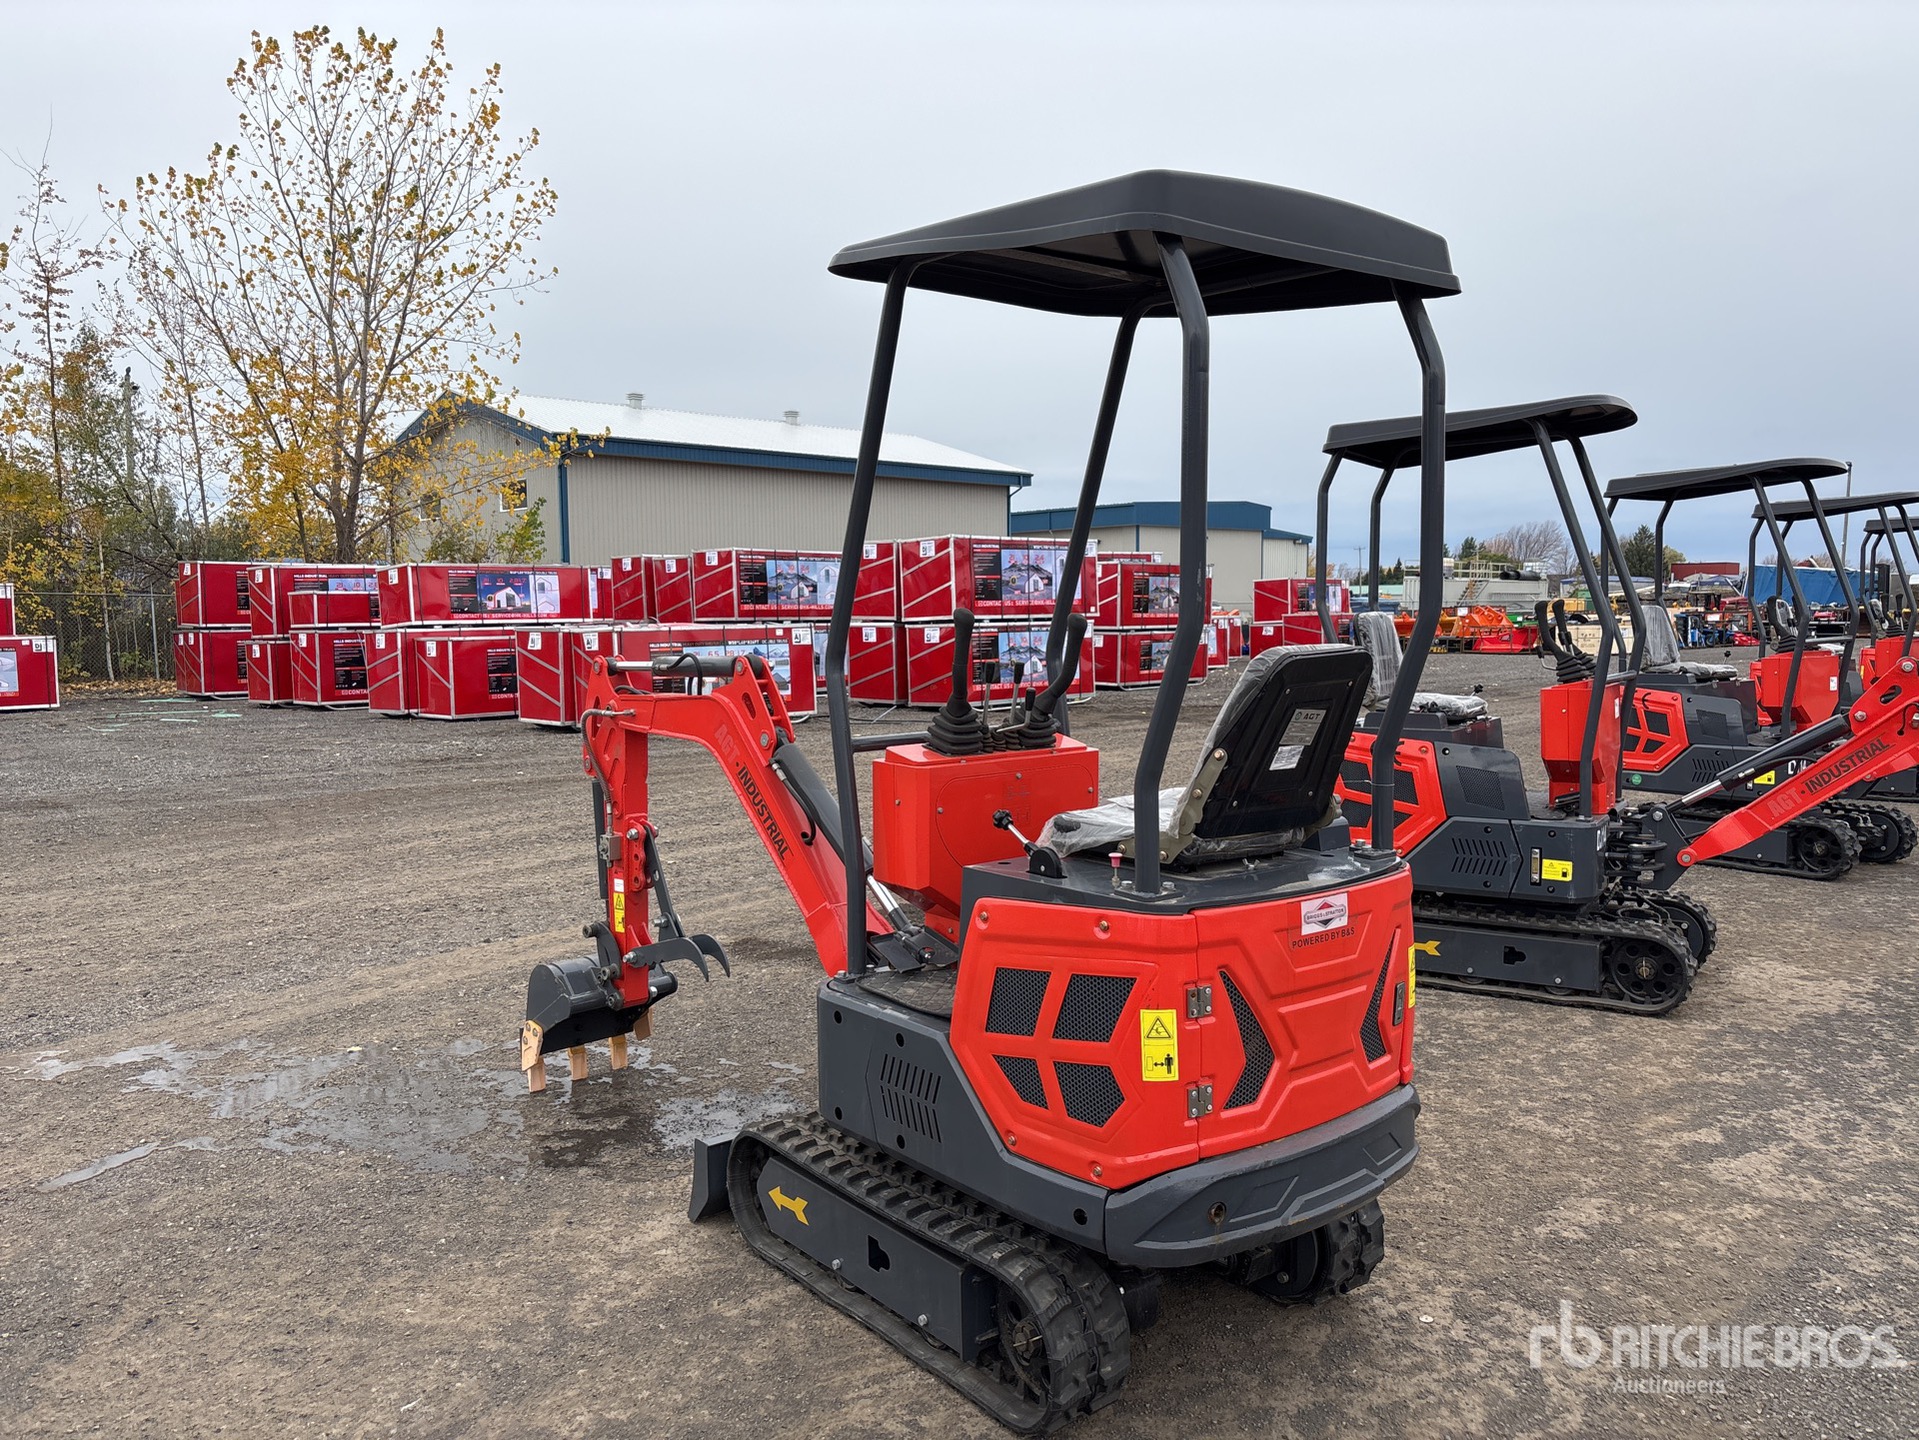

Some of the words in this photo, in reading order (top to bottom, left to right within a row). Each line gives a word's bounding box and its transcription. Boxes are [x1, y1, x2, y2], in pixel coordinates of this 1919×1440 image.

[714, 724, 740, 764] AGT
[737, 765, 789, 861] INDUSTRIAL
[1767, 787, 1803, 817] AGT
[1804, 737, 1890, 793] INDUSTRIAL
[1292, 933, 1330, 949] POWERED
[1331, 931, 1340, 940] BY
[1341, 927, 1355, 937] B&S
